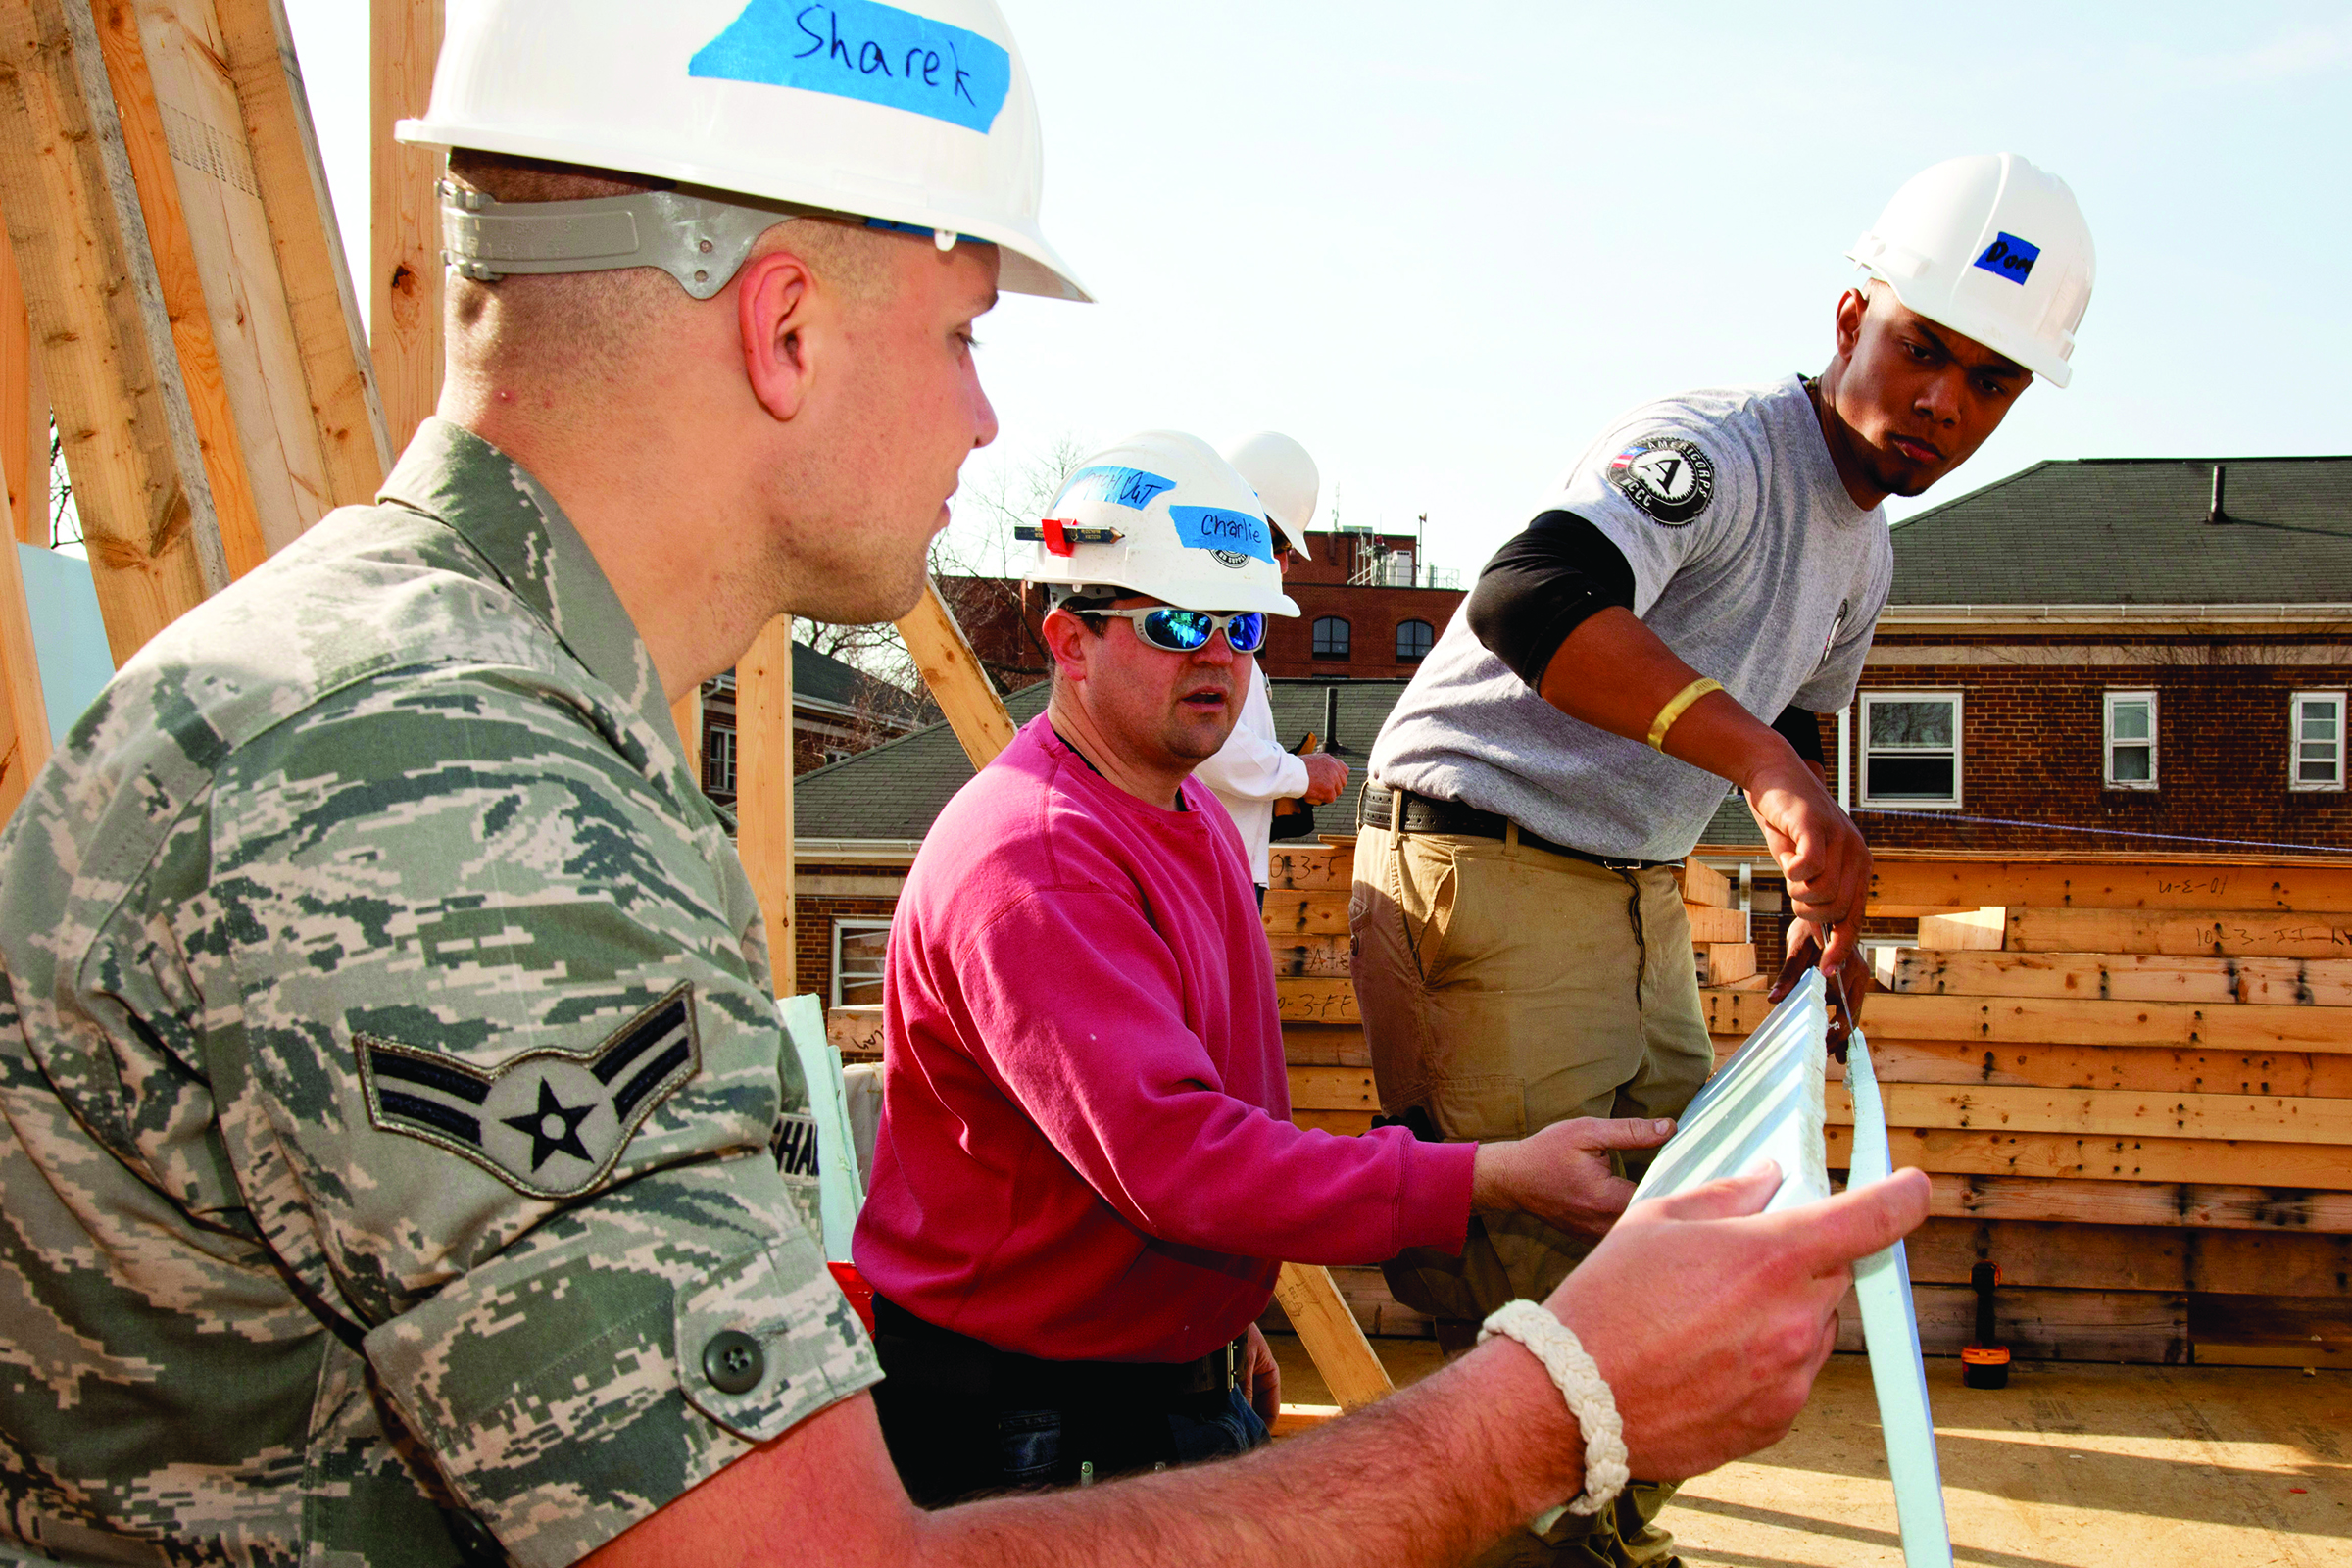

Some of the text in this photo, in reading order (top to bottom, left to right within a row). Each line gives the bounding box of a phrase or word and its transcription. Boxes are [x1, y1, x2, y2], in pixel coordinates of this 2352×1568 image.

[794, 3, 978, 108] Sharek
[1646, 439, 1712, 499] AMERICORPS
[1201, 514, 1262, 544] Charlie
